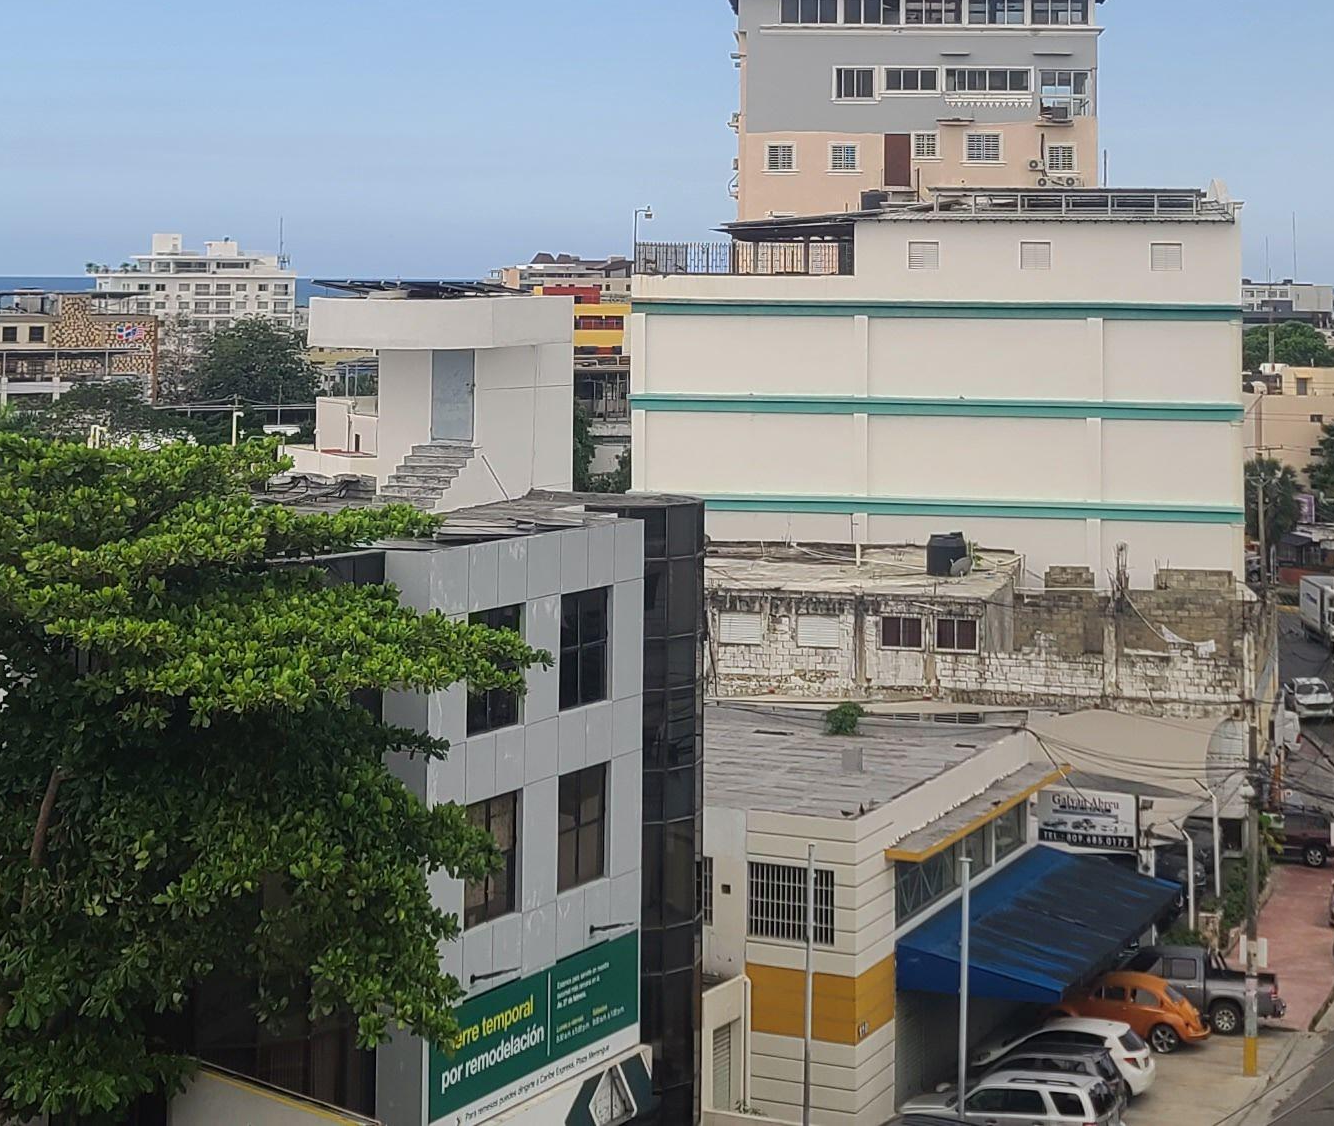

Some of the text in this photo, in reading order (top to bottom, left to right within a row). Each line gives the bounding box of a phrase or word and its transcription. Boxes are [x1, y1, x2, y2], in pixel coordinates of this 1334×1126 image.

[1090, 796, 1120, 810] Abreu
[481, 993, 534, 1036] temporal
[441, 1062, 463, 1094] por
[465, 1023, 545, 1078] remodelación
